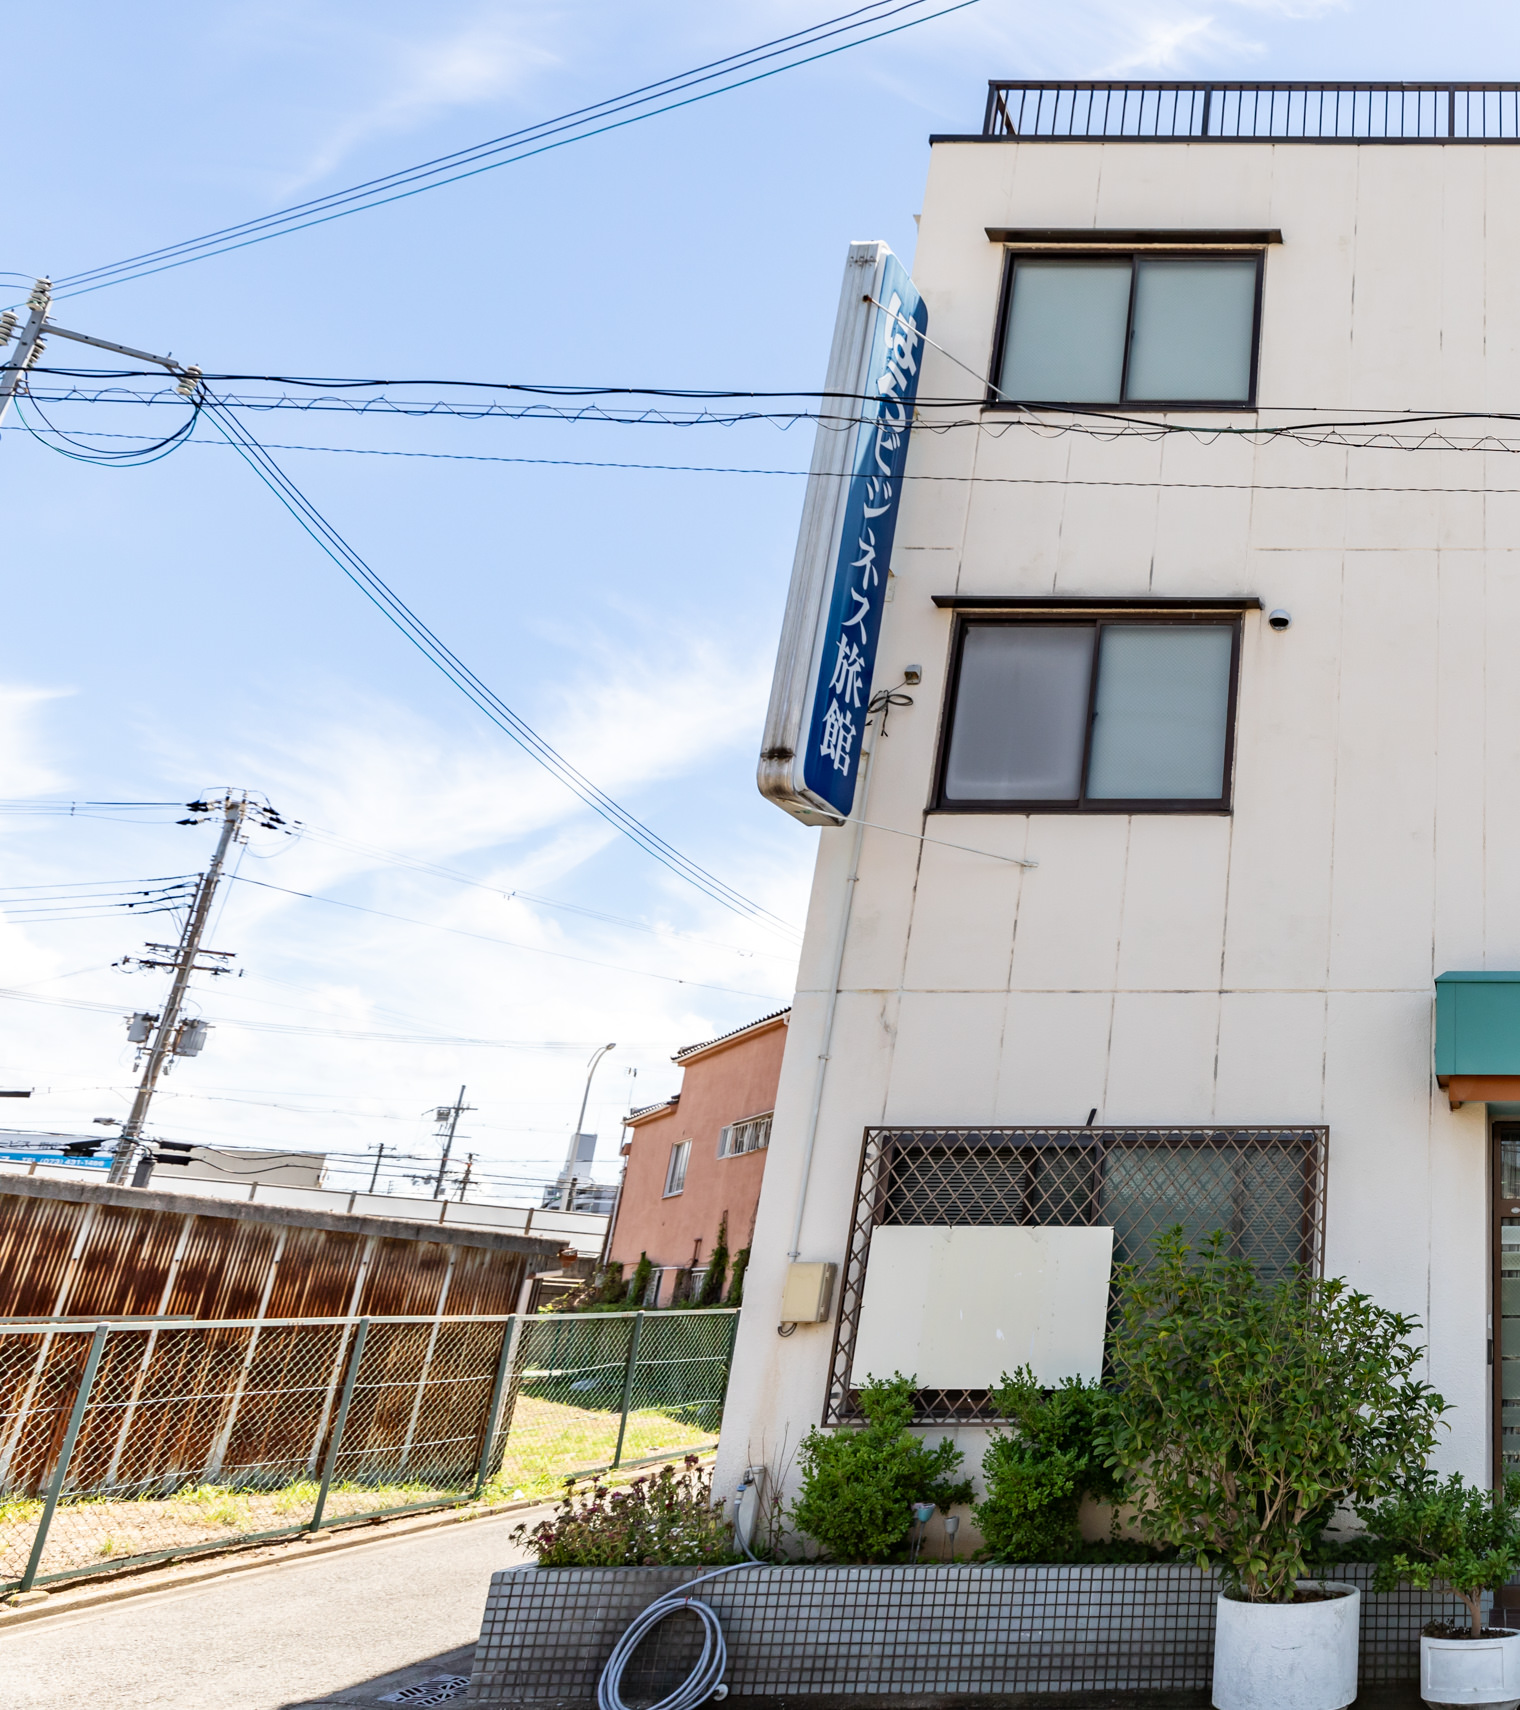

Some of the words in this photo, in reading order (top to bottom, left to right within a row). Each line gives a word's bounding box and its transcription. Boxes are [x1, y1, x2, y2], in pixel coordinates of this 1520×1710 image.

[819, 291, 918, 777] はらビジネス旅館
